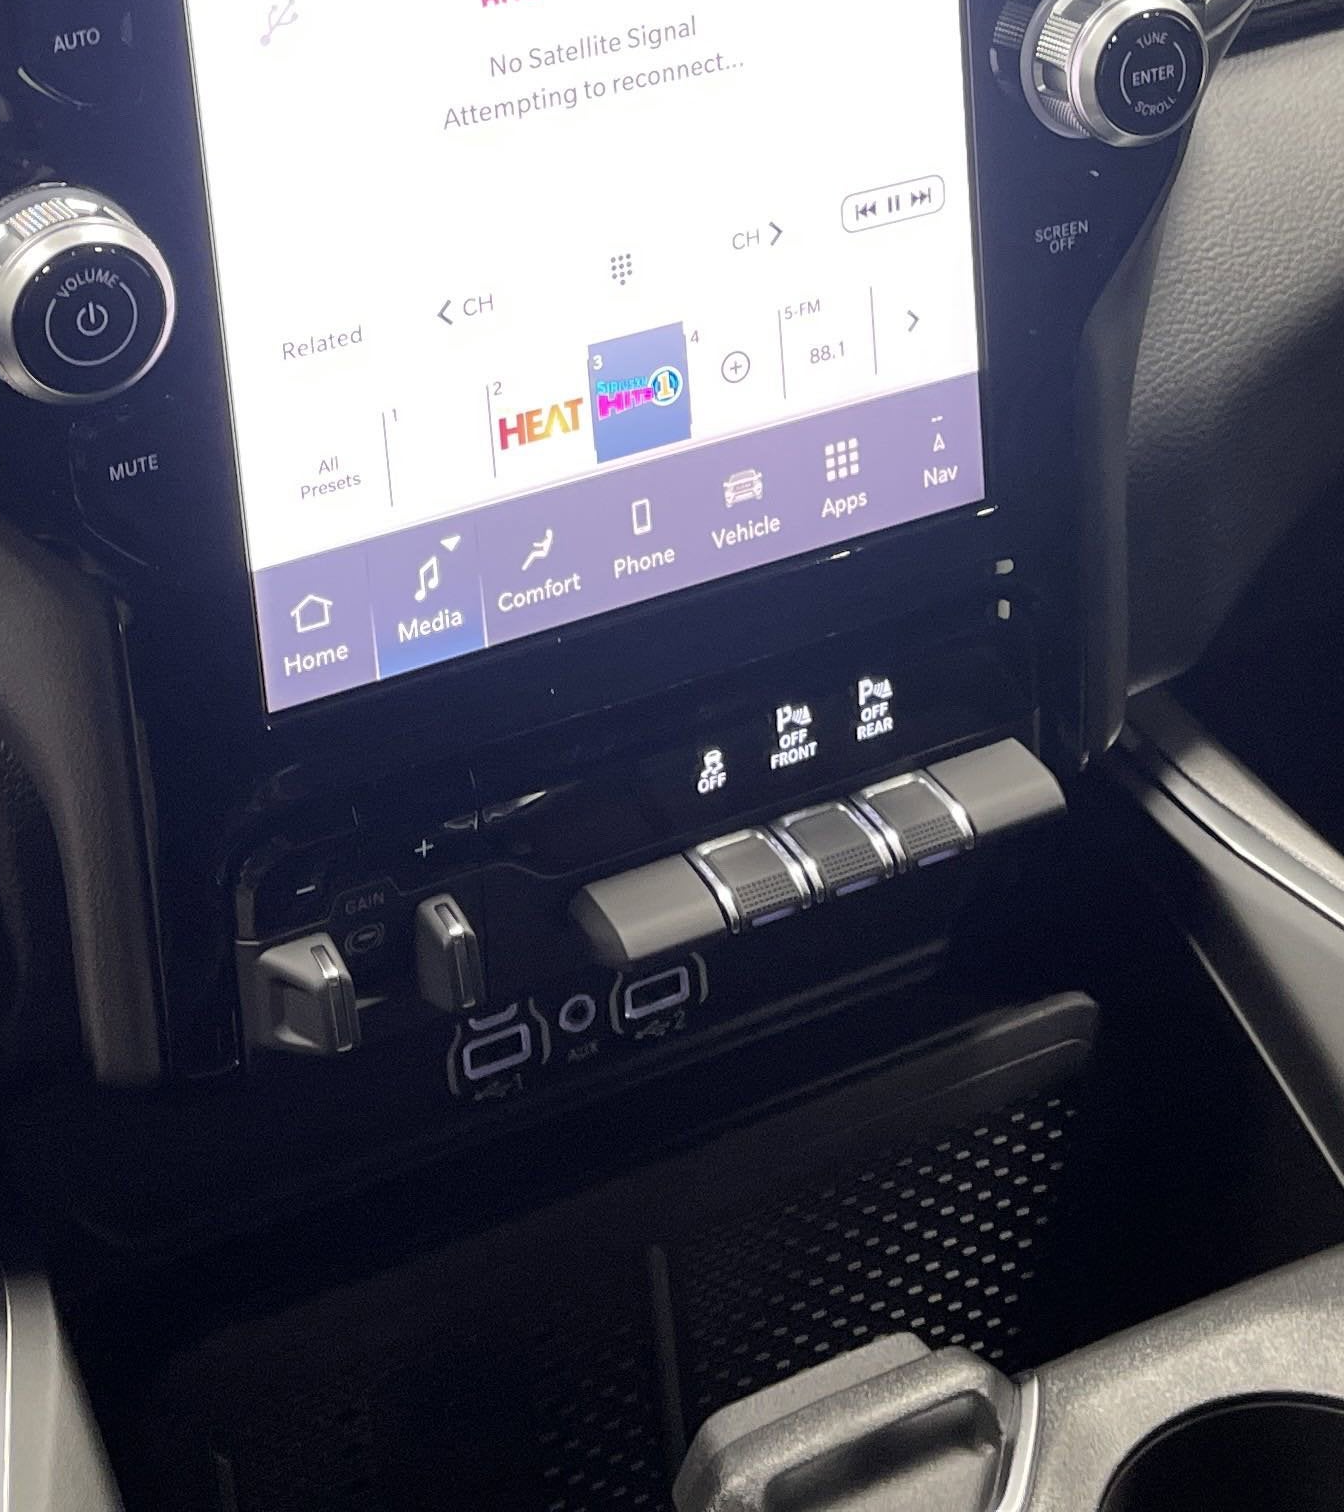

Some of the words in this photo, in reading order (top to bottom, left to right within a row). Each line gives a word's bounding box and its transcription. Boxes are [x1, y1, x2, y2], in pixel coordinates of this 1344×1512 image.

[52, 28, 101, 53] AUTO
[488, 54, 523, 78] No
[528, 35, 622, 70] Satellite
[626, 14, 698, 50] Signal
[1136, 31, 1169, 49] TUNE
[1132, 64, 1176, 87] ENTER
[442, 83, 579, 130] Attempting
[583, 78, 607, 99] to
[611, 52, 746, 94] reconnect...
[1134, 95, 1177, 117] SCROLL
[731, 230, 761, 251] CH
[1034, 219, 1089, 244] SCREEN
[1049, 236, 1076, 254] OFF
[56, 267, 119, 301] VOLUME
[462, 293, 495, 317] CH
[783, 299, 822, 320] 5-FM
[281, 324, 364, 361] Related
[689, 330, 700, 344] 4
[592, 354, 604, 370] 3
[809, 341, 847, 365] 88.1
[492, 381, 503, 397] 2
[390, 408, 399, 423] 1
[498, 397, 584, 451] HEAT
[108, 454, 160, 481] MUTE
[317, 456, 340, 475] All
[922, 463, 959, 489] Nav
[299, 471, 362, 500] Presets
[821, 492, 868, 519] Apps
[711, 515, 782, 550] Vehicle
[613, 546, 676, 579] Phone
[497, 573, 582, 614] Comfort
[398, 609, 463, 643] Media
[283, 642, 349, 677] Home
[860, 701, 889, 723] OFF
[778, 728, 808, 750] OFF
[856, 717, 894, 741] REAR
[769, 741, 818, 771] FRONT
[696, 772, 727, 794] OFF
[344, 891, 386, 915] GAIN
